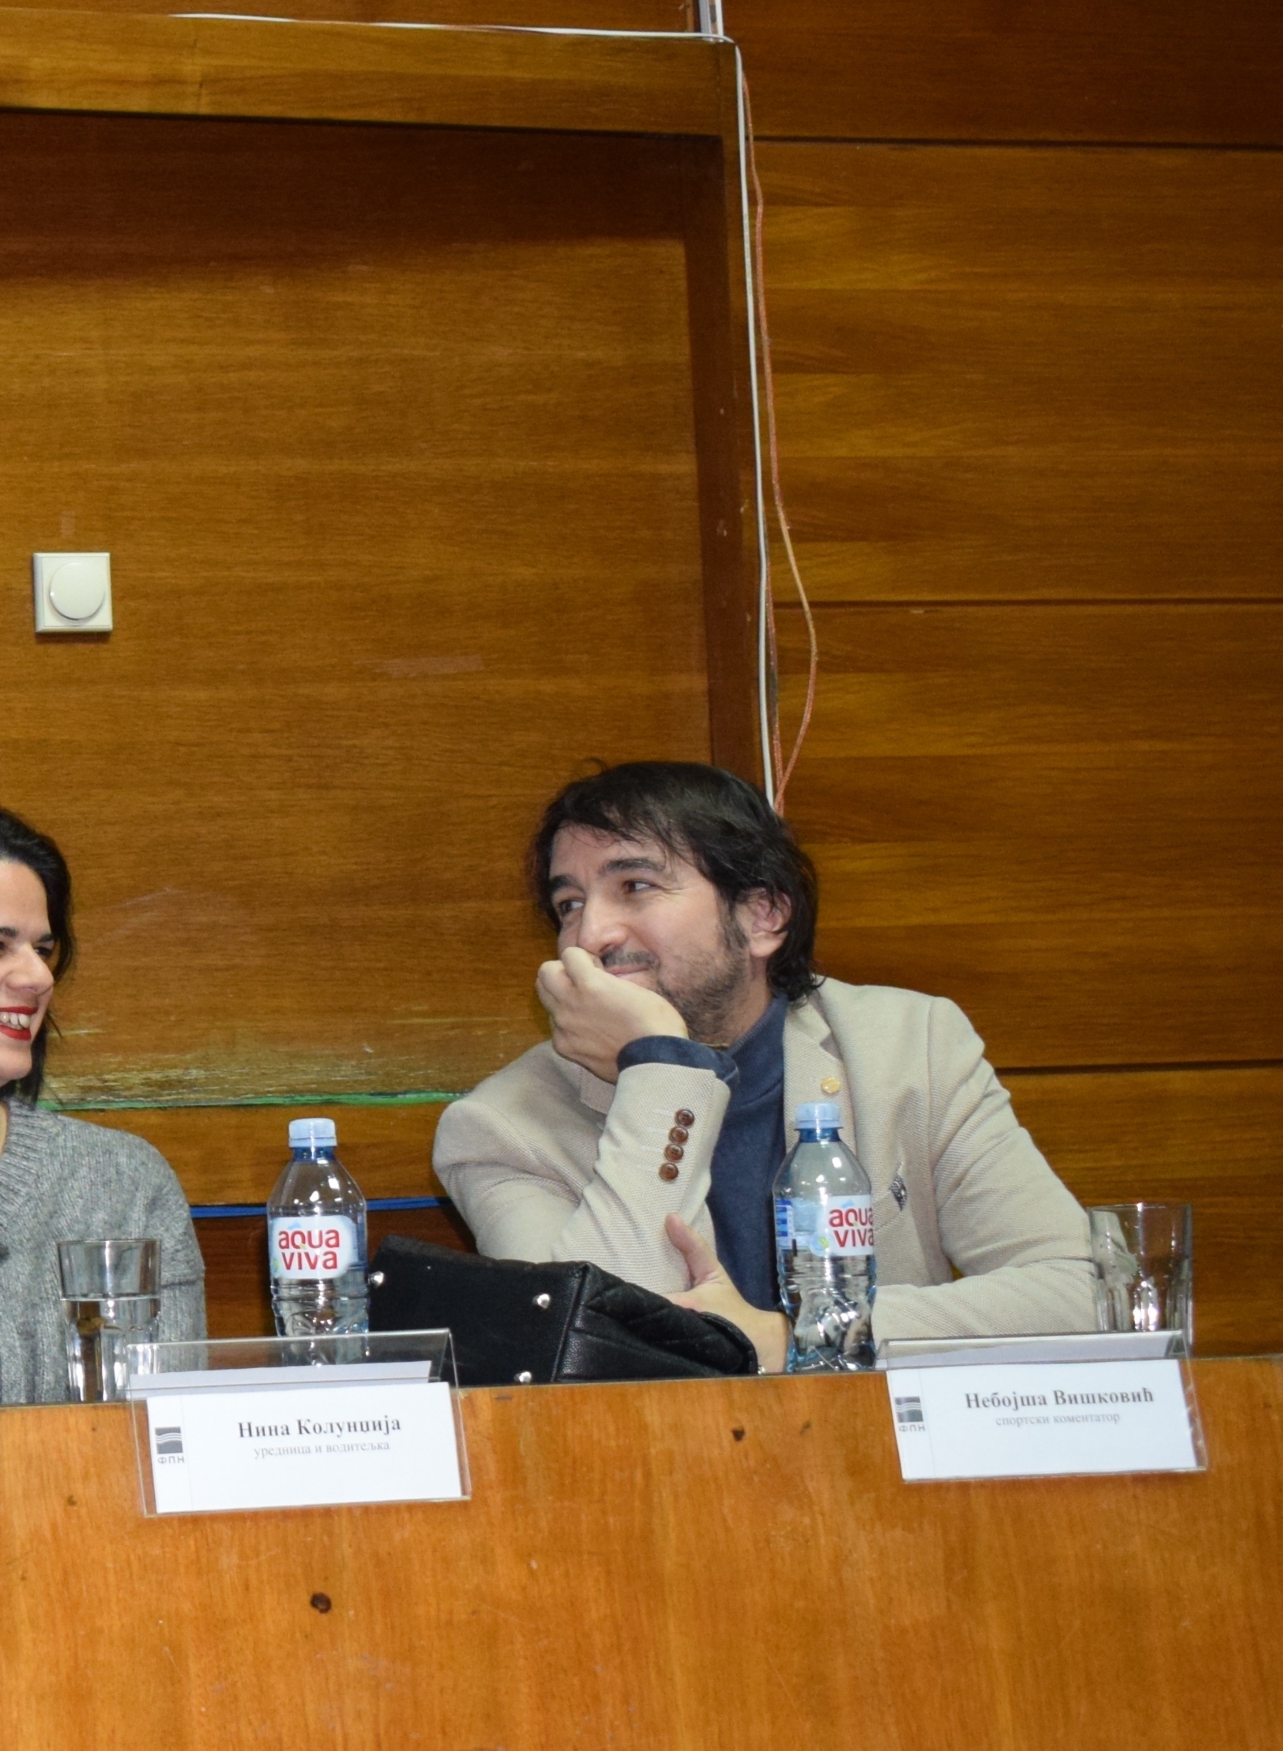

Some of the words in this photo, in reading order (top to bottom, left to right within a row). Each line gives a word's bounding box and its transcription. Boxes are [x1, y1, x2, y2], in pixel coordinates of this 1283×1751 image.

[278, 1229, 340, 1250] aqua
[282, 1251, 338, 1270] viva
[965, 1392, 1047, 1411] Небојша
[1054, 1387, 1154, 1406] Вишковић
[237, 1421, 290, 1438] Нина
[296, 1415, 401, 1437] Колунџија
[899, 1423, 926, 1432] ФПН
[995, 1415, 1049, 1427] спортски
[1053, 1413, 1120, 1424] коментатор
[253, 1446, 311, 1459] уредница
[326, 1441, 390, 1454] водитељка
[157, 1456, 185, 1465] ФПН
